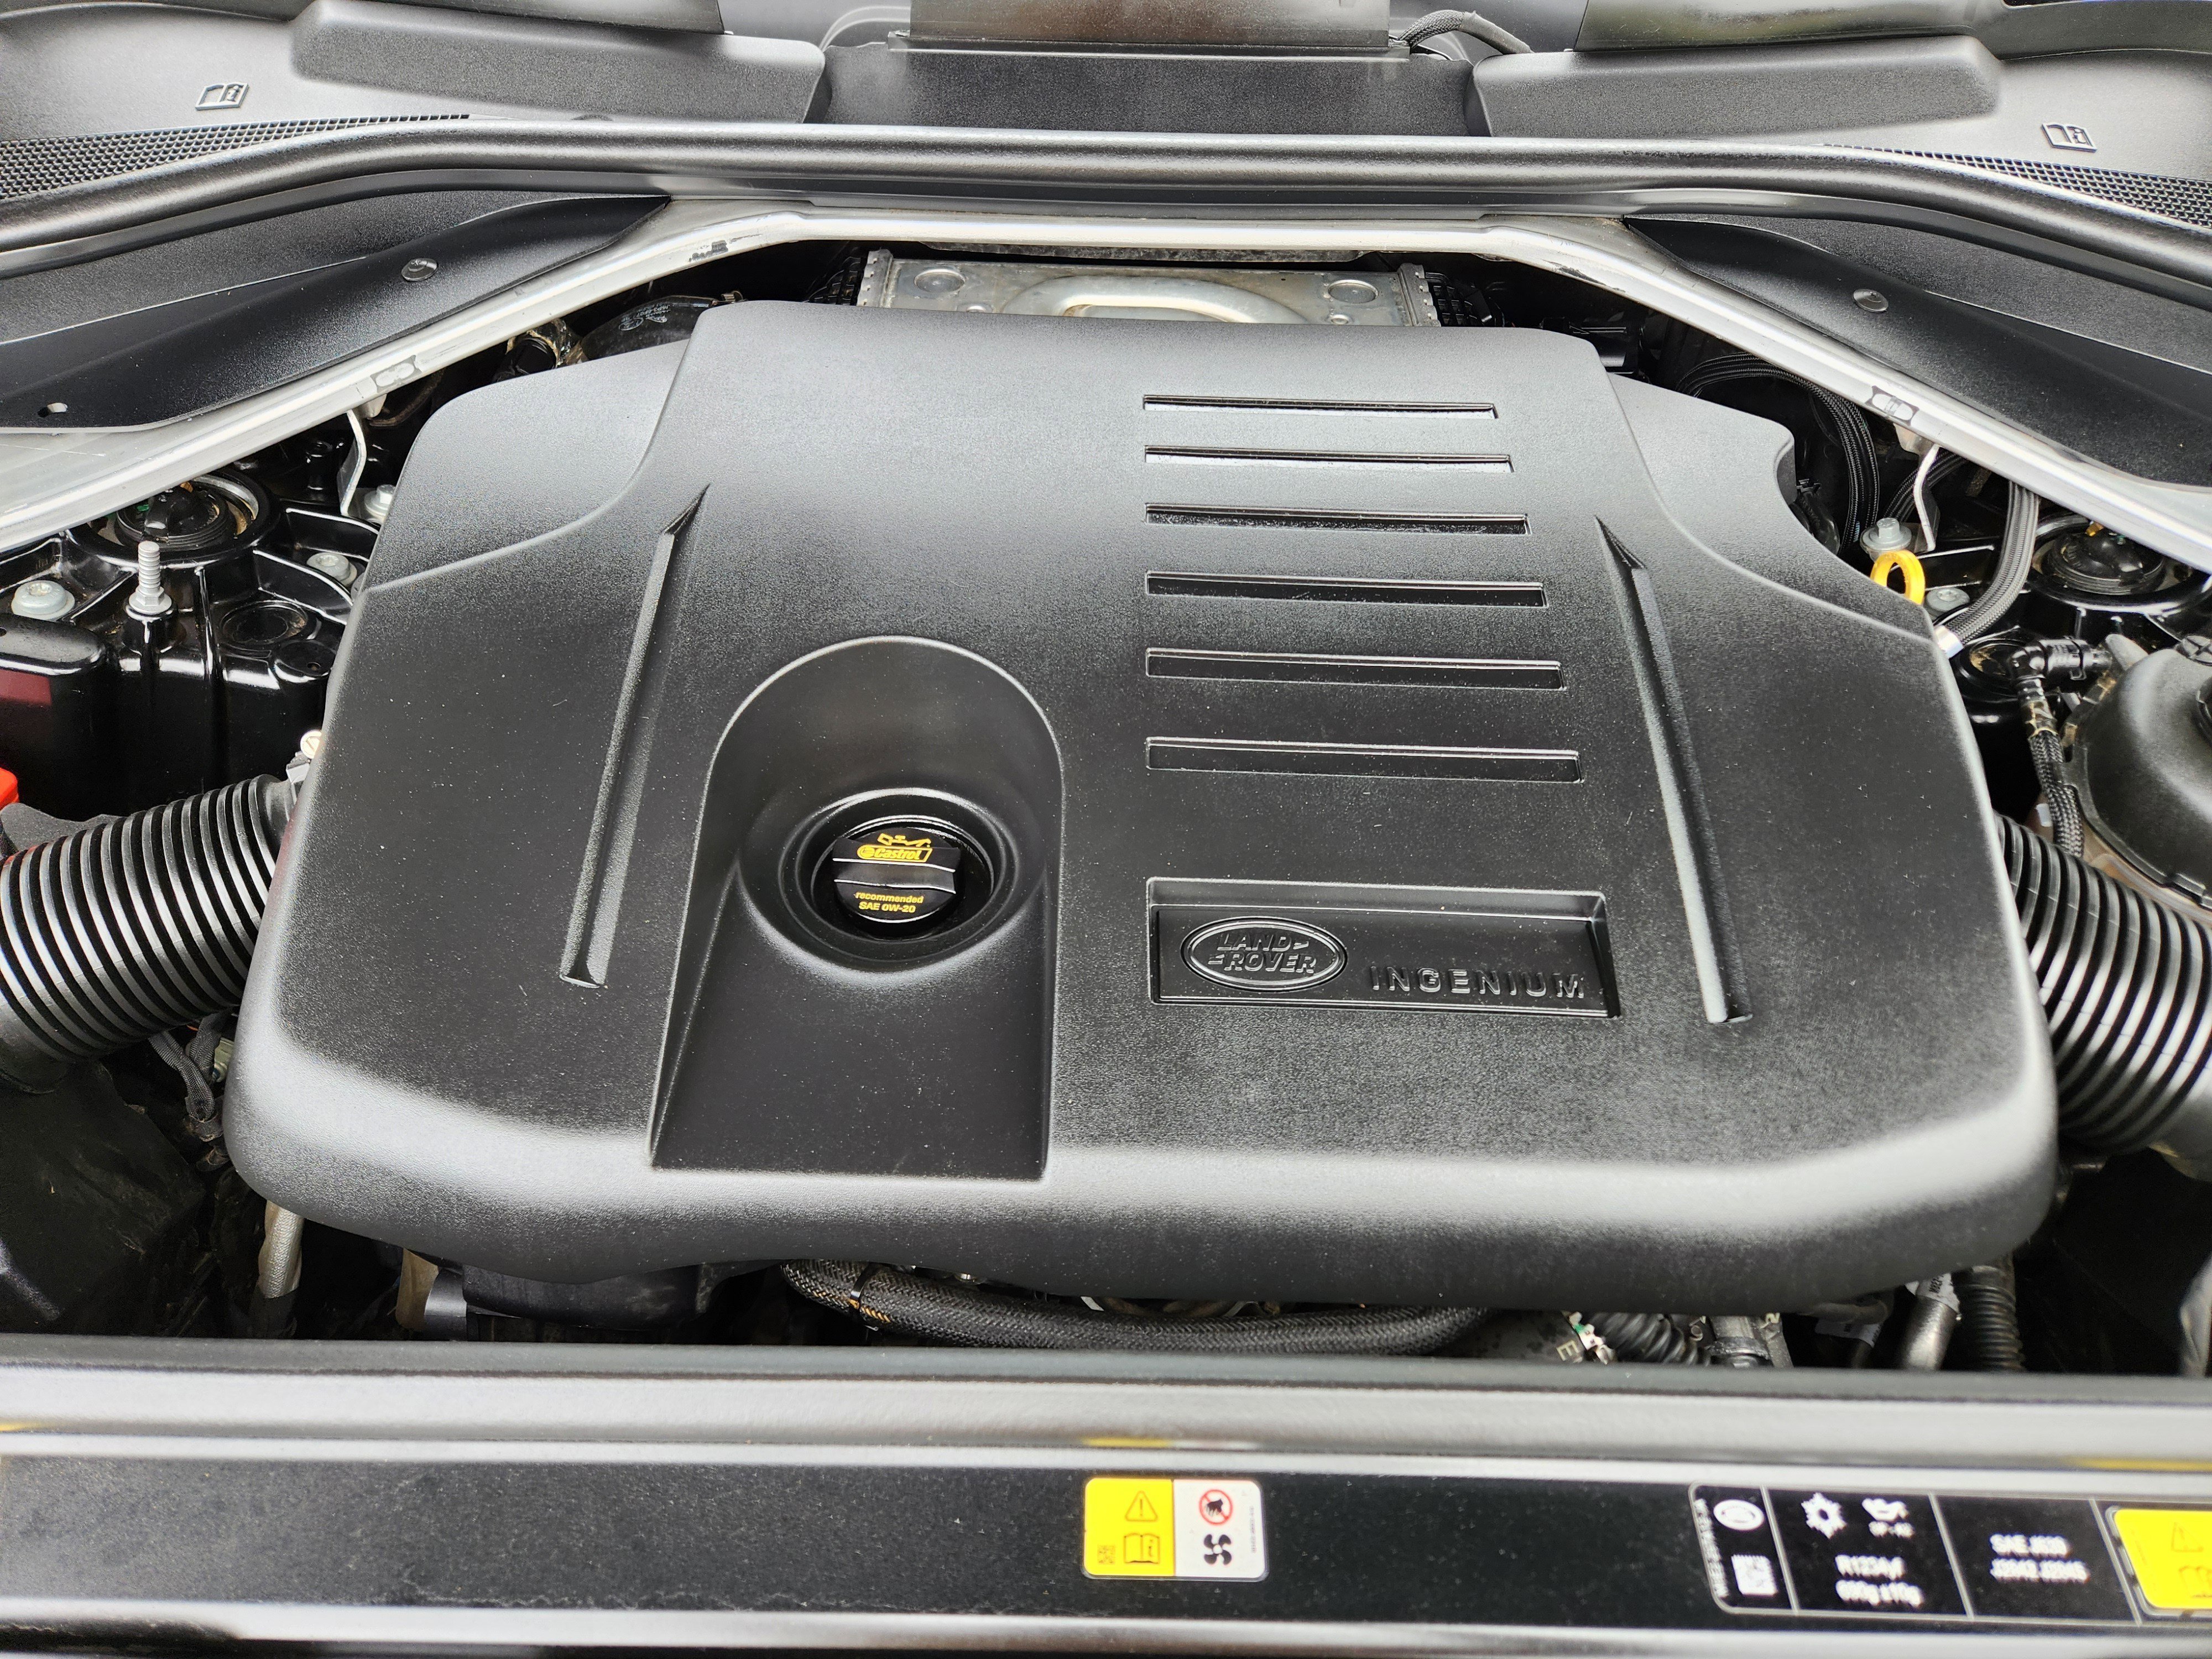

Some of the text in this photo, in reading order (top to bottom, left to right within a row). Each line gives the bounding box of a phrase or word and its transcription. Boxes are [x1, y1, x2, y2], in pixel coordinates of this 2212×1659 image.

[874, 848, 922, 859] Castrol
[855, 892, 924, 904] recommended
[859, 901, 916, 913] SAE 0W-20
[1216, 932, 1291, 952] LAND
[1223, 952, 1317, 973] ROVER
[1370, 966, 1585, 998] INGENIUM
